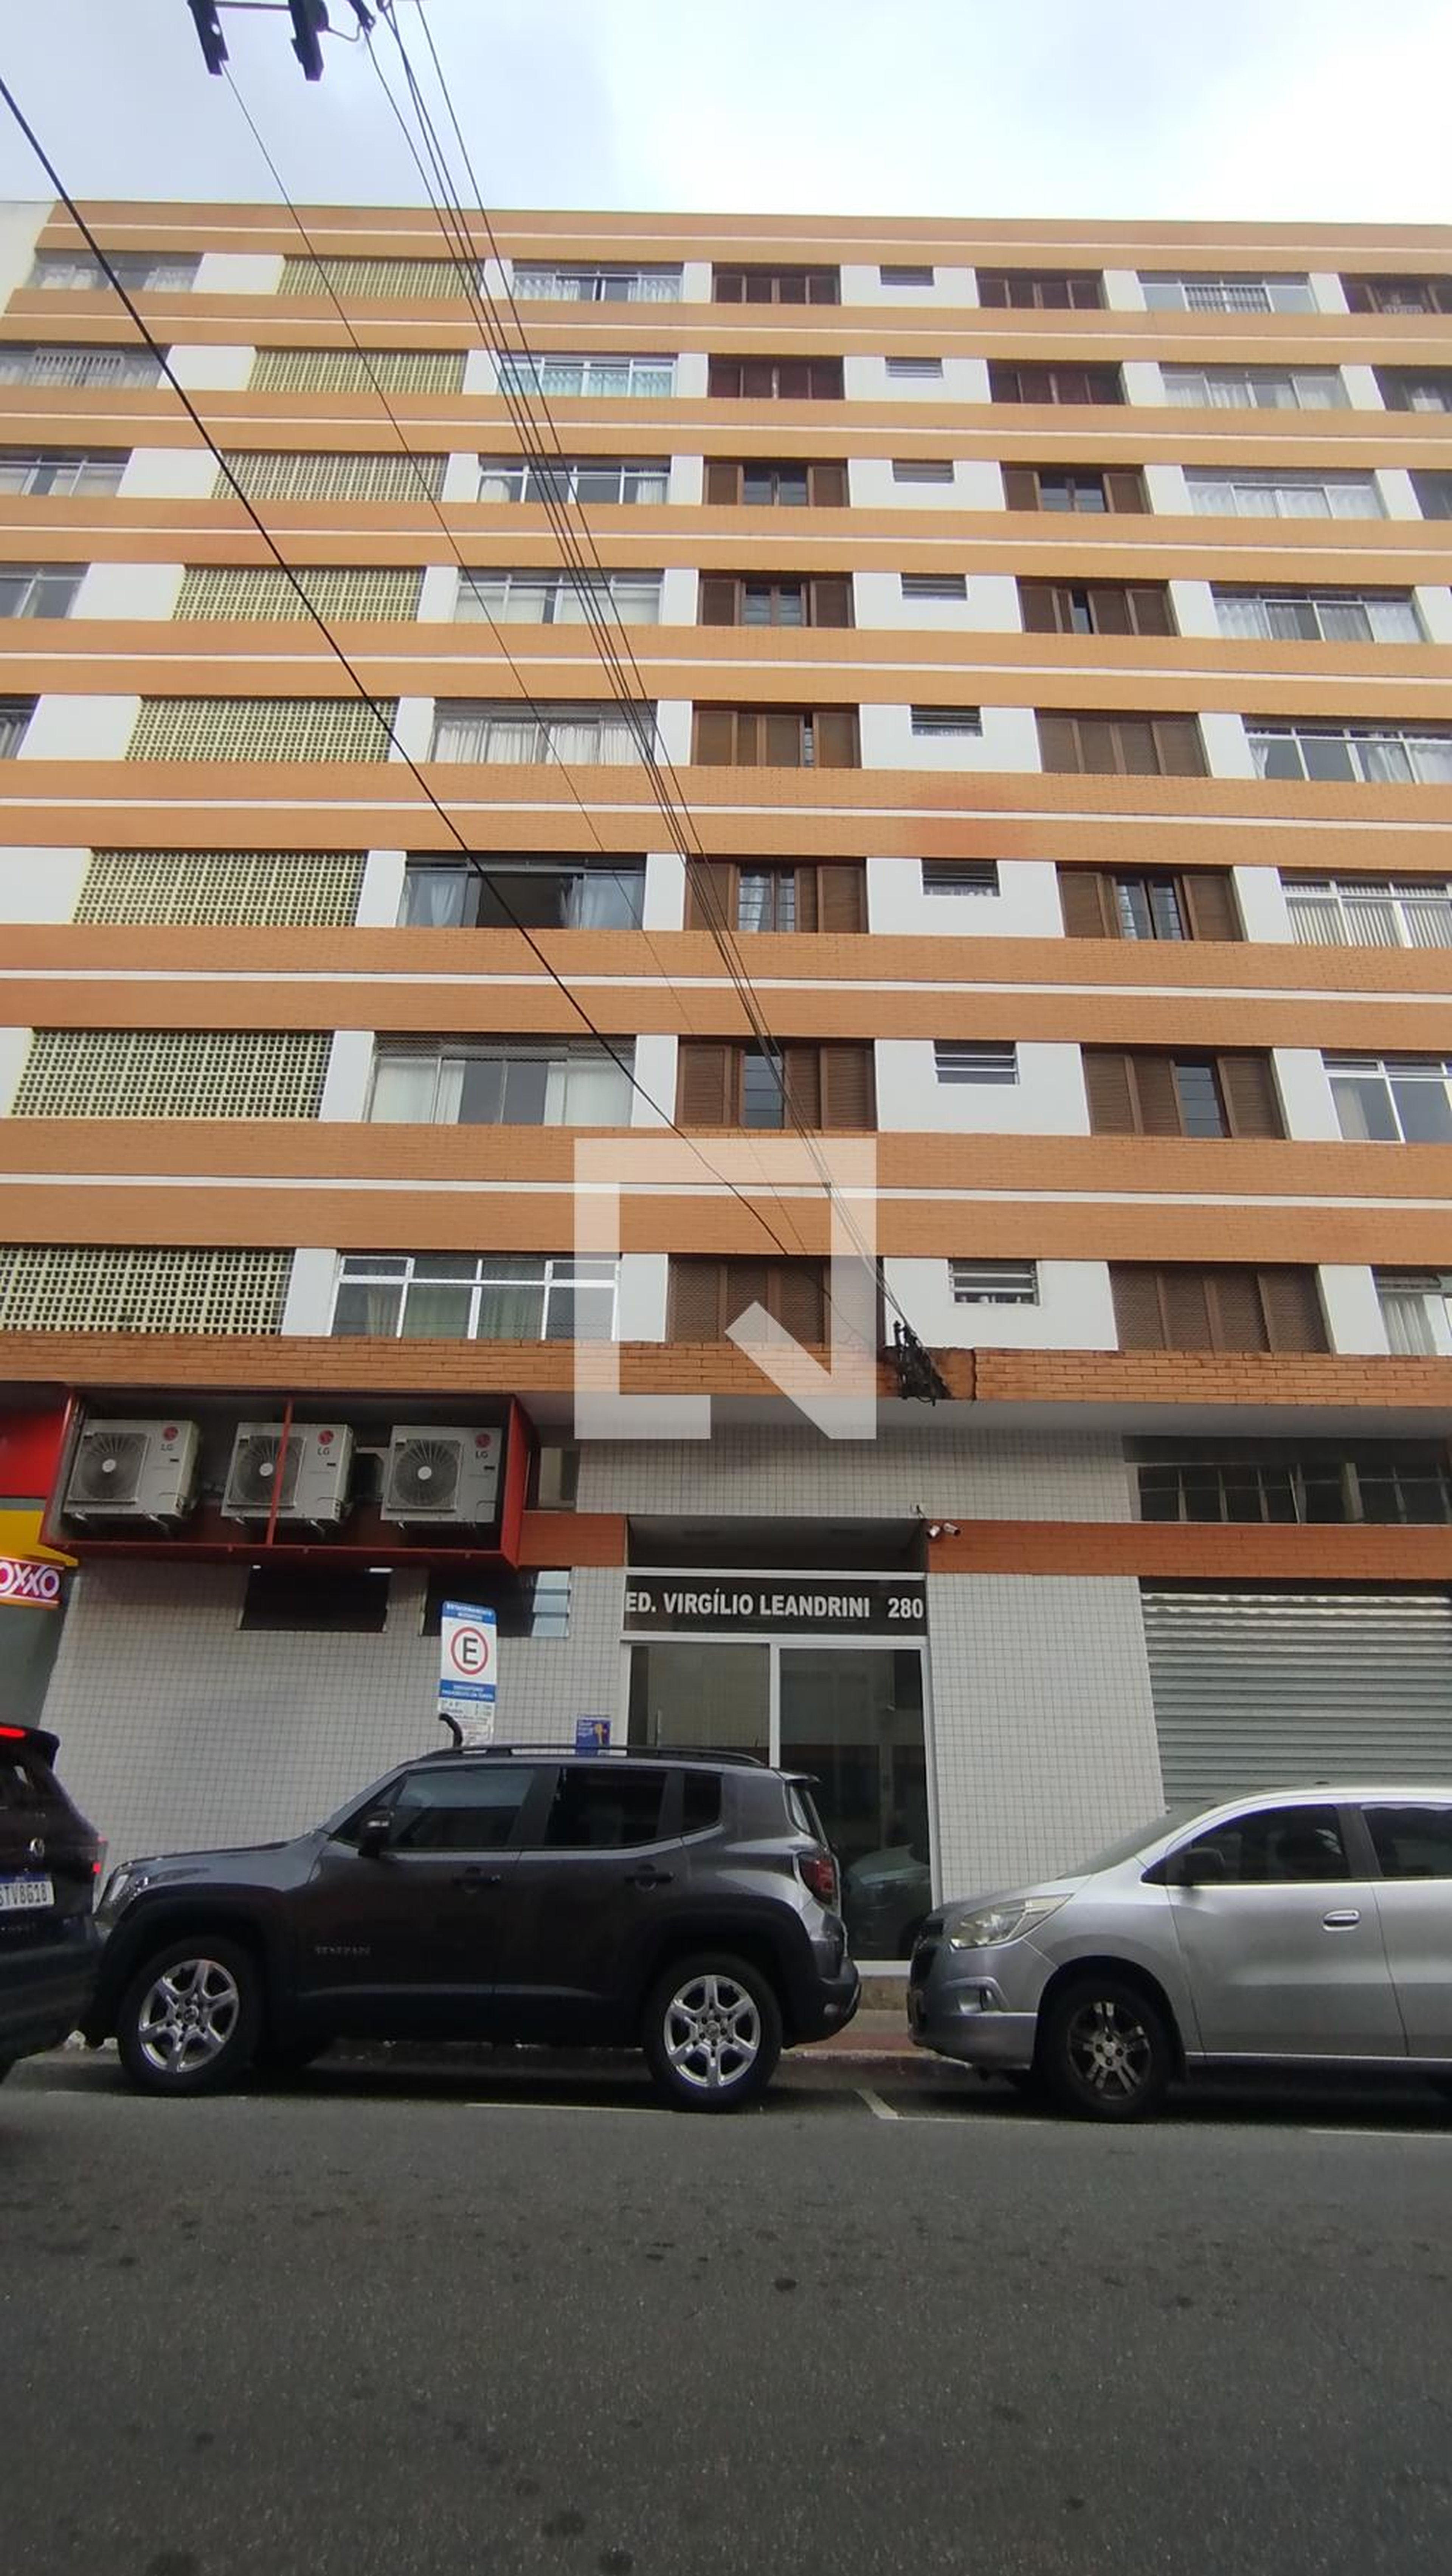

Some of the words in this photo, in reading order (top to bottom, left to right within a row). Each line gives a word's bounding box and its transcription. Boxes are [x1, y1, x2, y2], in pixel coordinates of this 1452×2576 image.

[317, 1447, 330, 1456] LG
[0, 1561, 60, 1598] OXXO
[625, 1592, 656, 1612] ED.
[663, 1587, 754, 1615] VIRGÍLIO
[760, 1594, 870, 1618] LEANDRINI
[887, 1597, 924, 1618] 280
[463, 1637, 478, 1665] E
